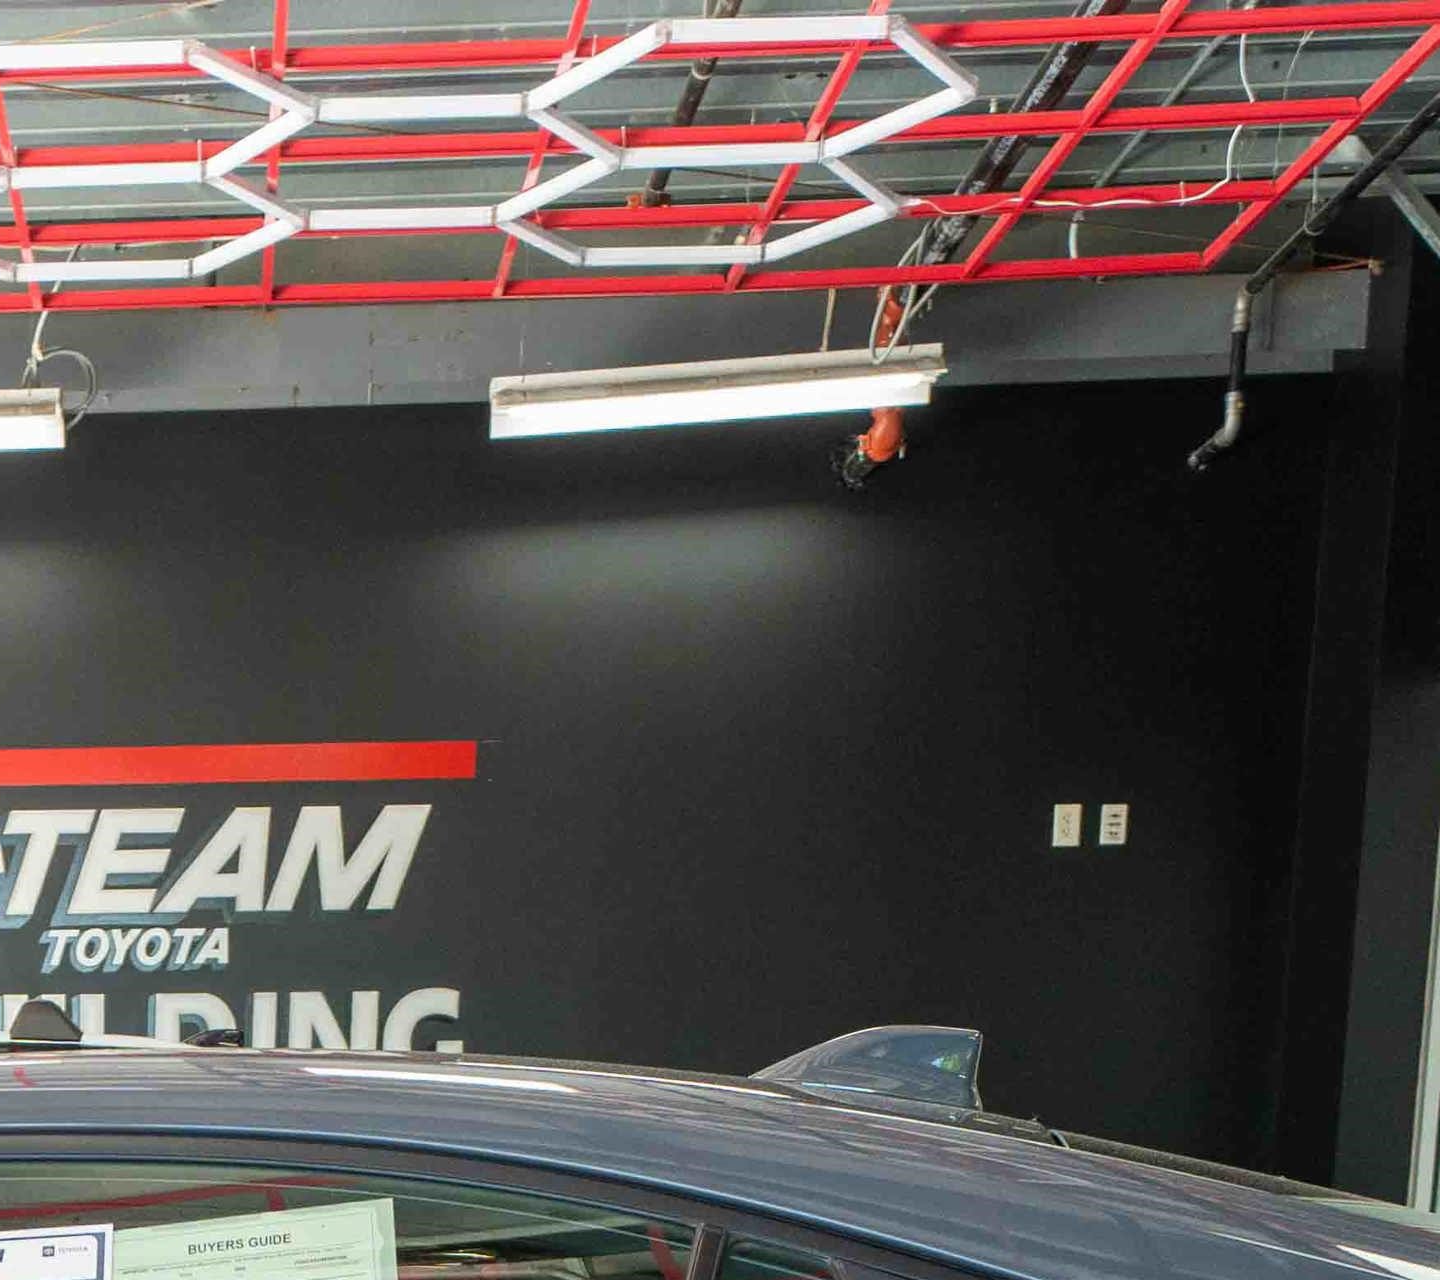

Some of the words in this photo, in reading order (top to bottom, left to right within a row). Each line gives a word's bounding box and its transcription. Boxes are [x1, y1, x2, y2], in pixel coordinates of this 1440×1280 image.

[42, 926, 231, 974] TOYOTA
[188, 1239, 244, 1255] BUYERS
[248, 1233, 291, 1248] GUIDE
